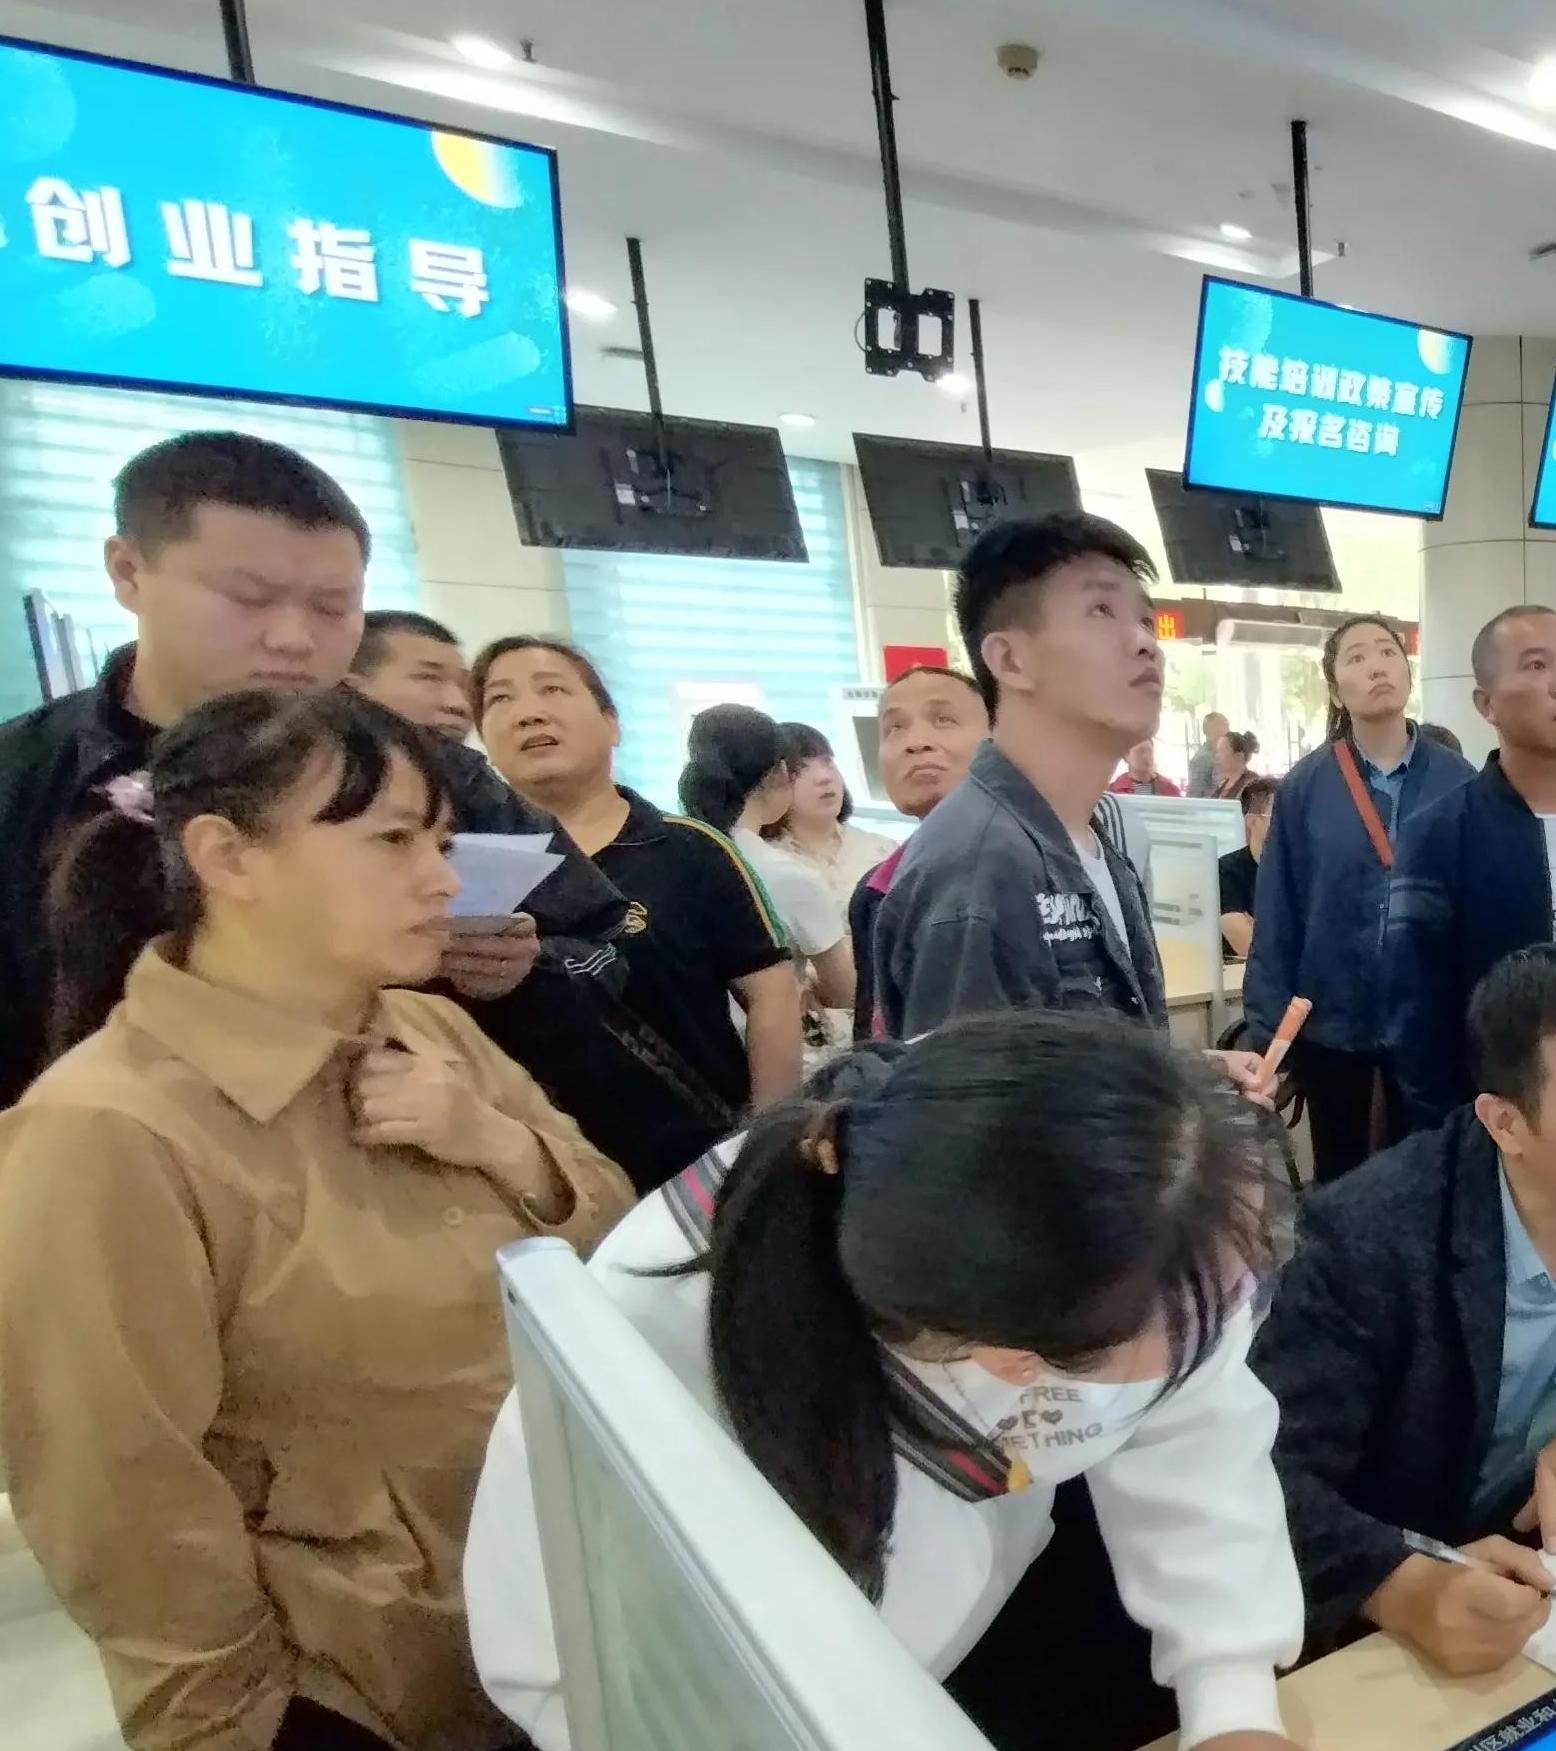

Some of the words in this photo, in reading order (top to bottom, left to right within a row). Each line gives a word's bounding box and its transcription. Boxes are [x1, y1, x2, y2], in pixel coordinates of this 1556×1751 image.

[26, 176, 489, 320] 创业指导
[1218, 345, 1446, 420] 技能培训政策宣传
[1256, 402, 1400, 457] 及报名咨询
